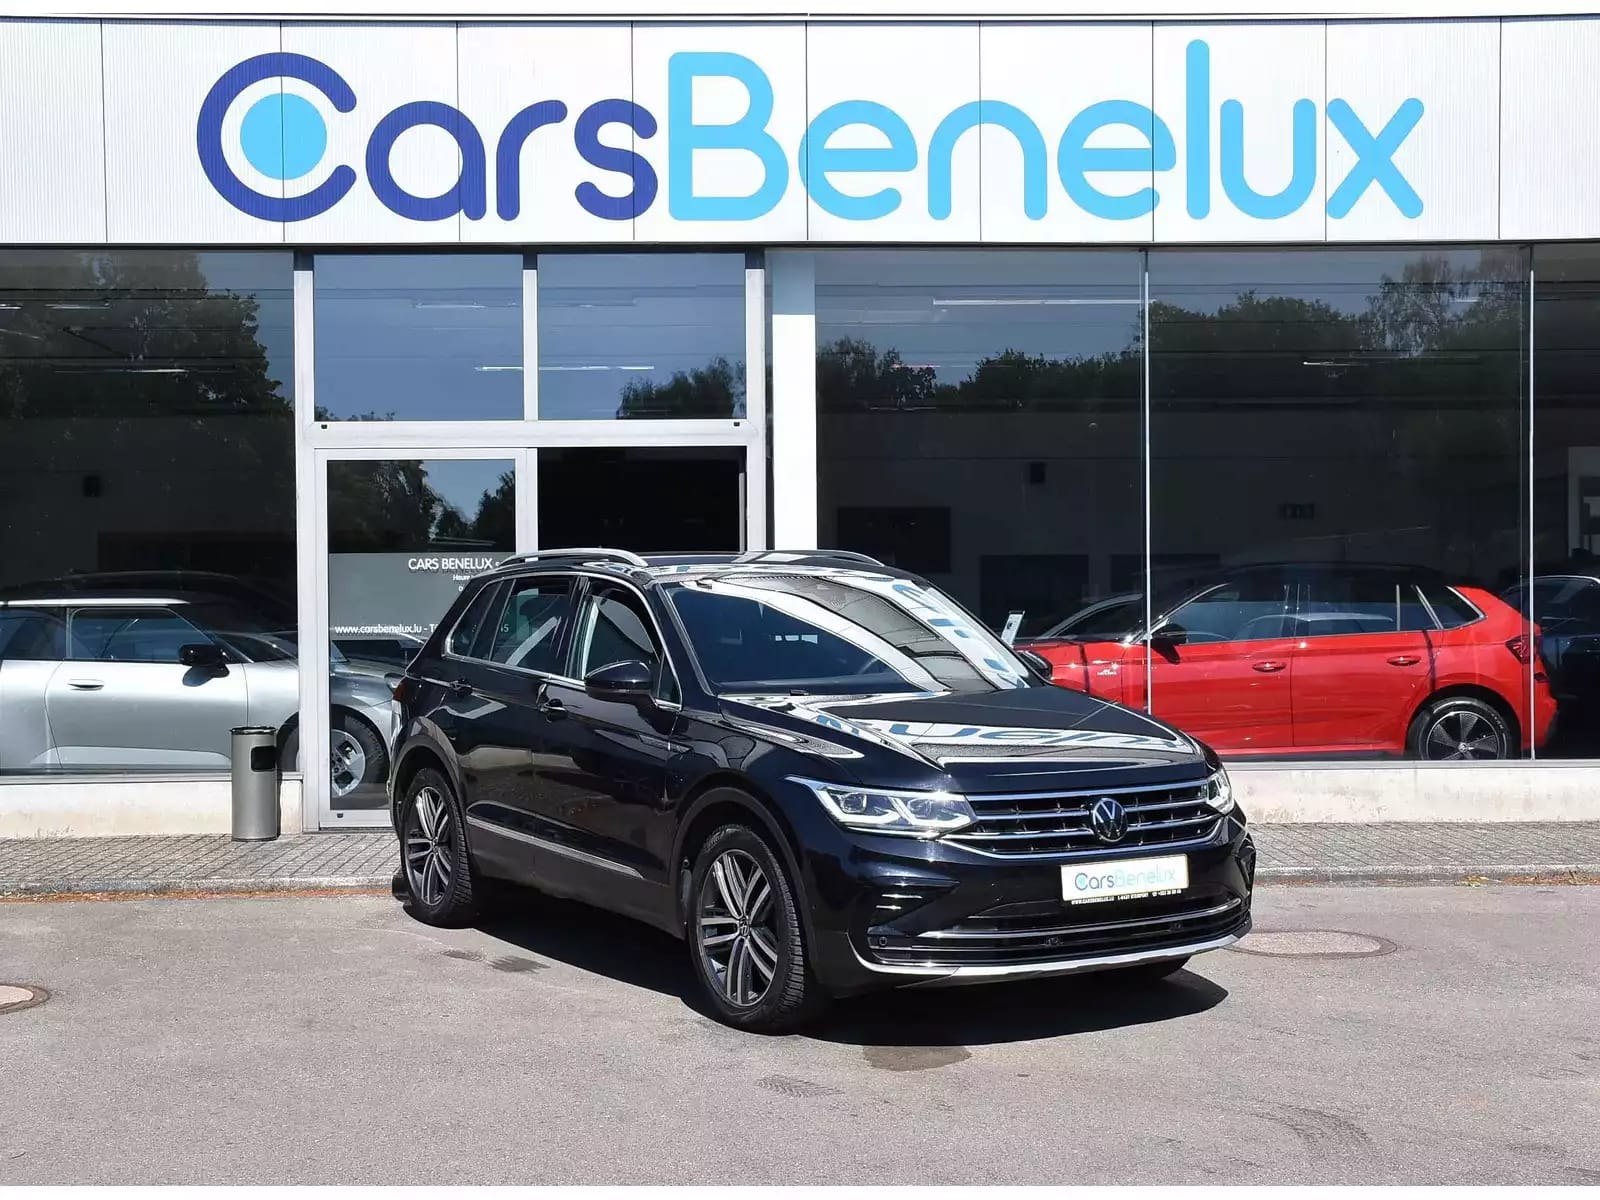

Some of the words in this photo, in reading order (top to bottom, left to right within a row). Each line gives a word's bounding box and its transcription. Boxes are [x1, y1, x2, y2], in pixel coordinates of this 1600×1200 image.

[197, 41, 1423, 222] CarsBenelux
[408, 558, 439, 570] CARS
[441, 557, 493, 569] BENELUX
[335, 623, 422, 634] www.carsbenelux.lu
[1074, 864, 1176, 891] CarsBenelux
